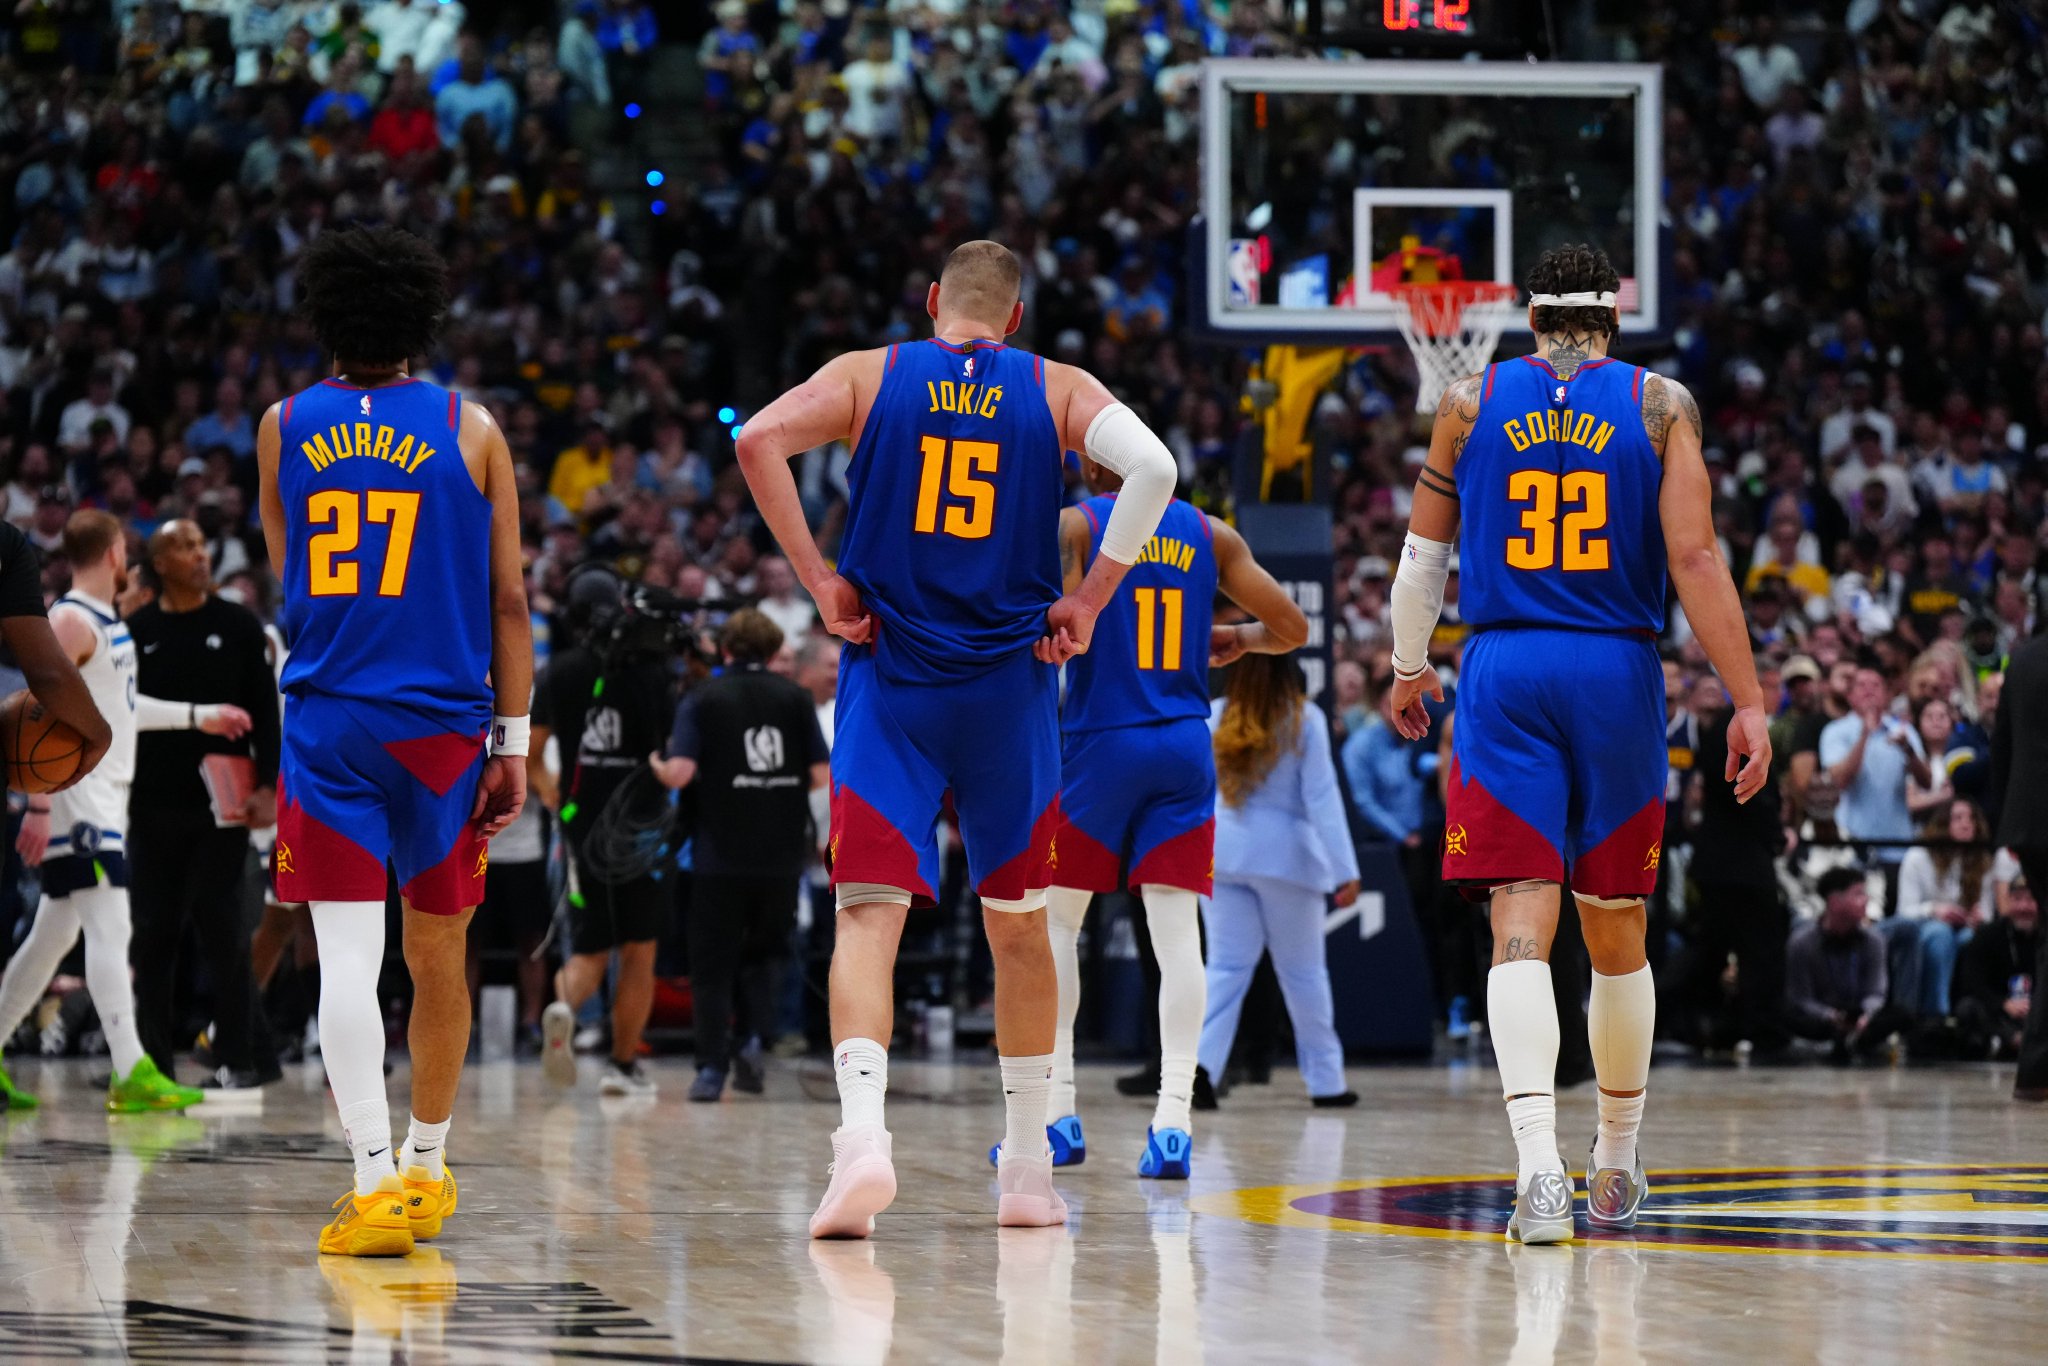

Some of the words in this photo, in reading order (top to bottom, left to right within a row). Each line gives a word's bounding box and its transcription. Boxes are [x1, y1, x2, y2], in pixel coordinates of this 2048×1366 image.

[927, 380, 1003, 419] JOKIĆ
[1503, 409, 1615, 454] GORDON
[301, 422, 436, 474] MURRAY
[914, 434, 999, 540] 15
[1505, 468, 1610, 572] 32
[307, 488, 422, 598] 27
[1135, 535, 1196, 573] OWN
[1133, 586, 1183, 671] 11
